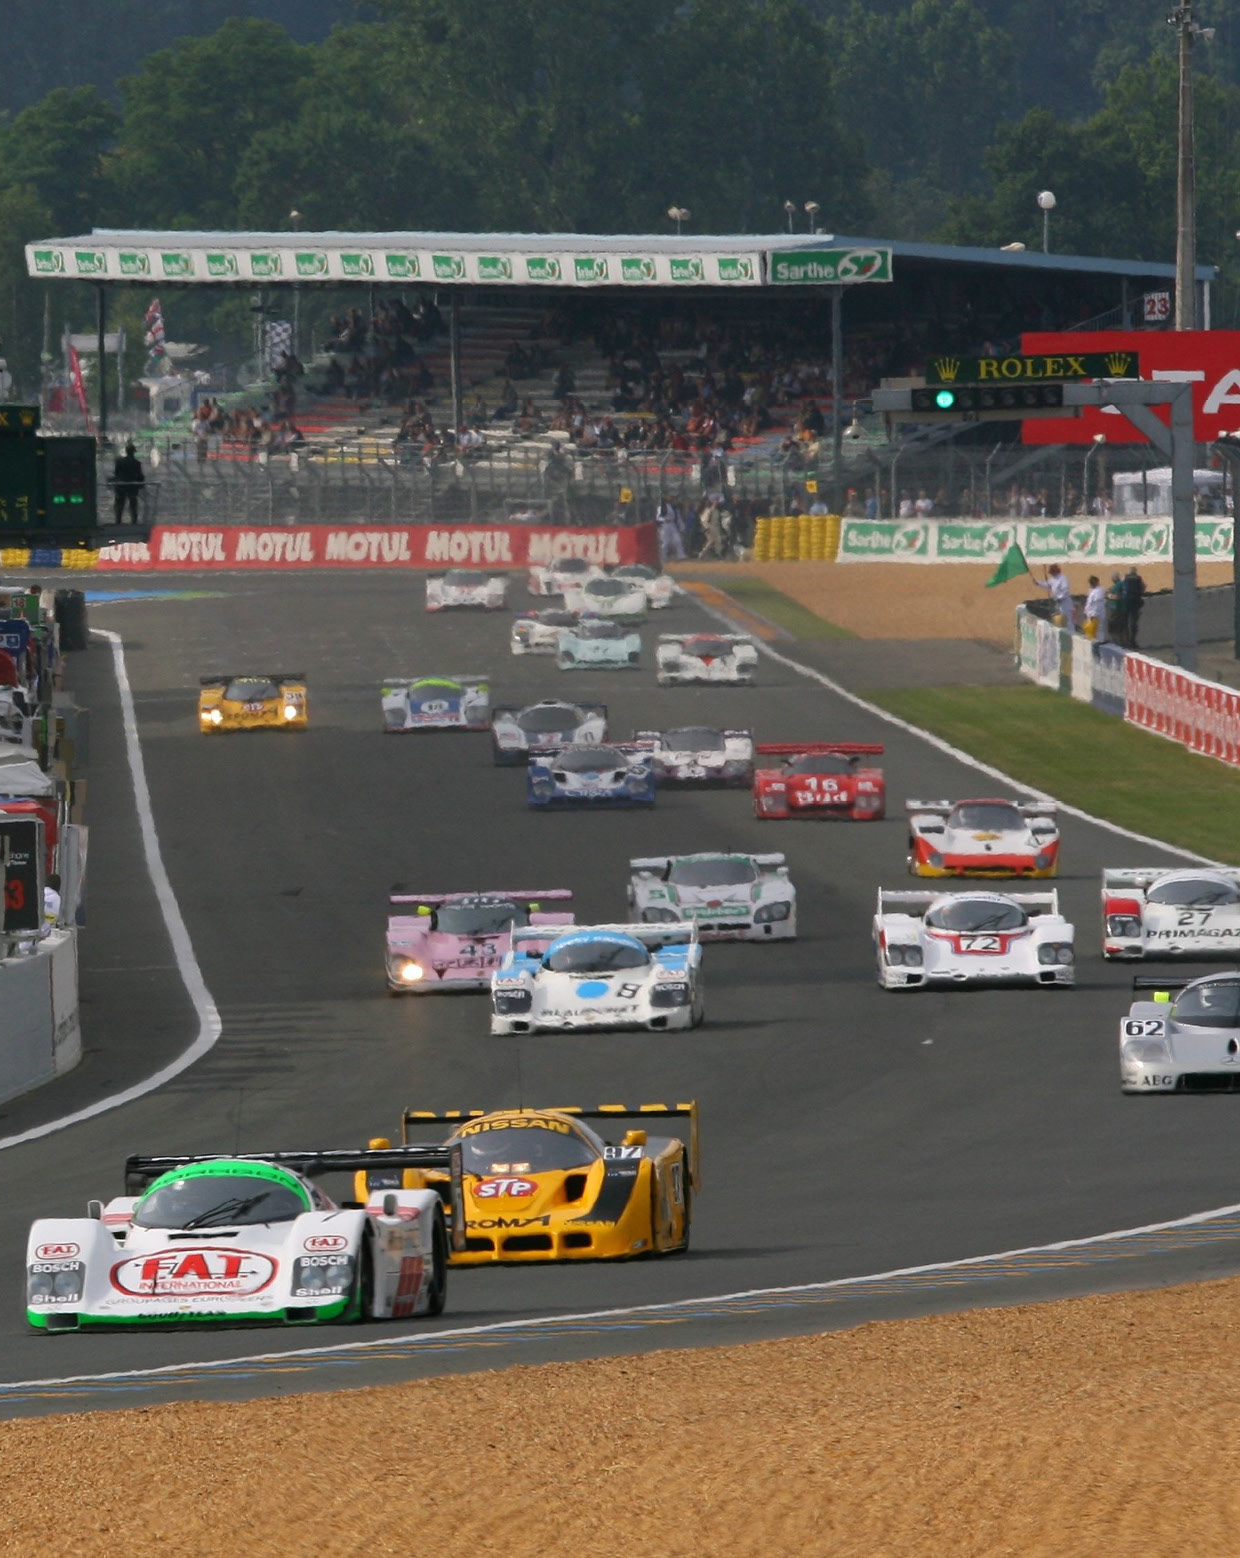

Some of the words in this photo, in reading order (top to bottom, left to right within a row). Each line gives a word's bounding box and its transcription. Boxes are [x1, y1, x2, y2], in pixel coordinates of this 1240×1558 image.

[776, 262, 834, 280] Sarthe
[1146, 298, 1170, 315] 23
[978, 356, 1088, 381] ROLEX
[160, 531, 226, 562] MOTUL
[235, 531, 314, 562] MOTUL
[325, 531, 411, 562] MOTUL
[425, 530, 513, 563] MOTUL
[846, 529, 891, 548] Sarthe
[1107, 531, 1142, 550] Sarthe
[527, 531, 620, 564] MOTUL
[1177, 911, 1213, 926] 27
[459, 942, 498, 957] 43
[961, 936, 1000, 951] 72
[615, 982, 642, 999] 8
[1125, 1021, 1165, 1036] 62
[1142, 1075, 1173, 1086] AEG
[461, 1118, 570, 1138] NISSAN
[478, 1178, 532, 1197] STP
[32, 1262, 80, 1273] BOSCH
[300, 1256, 349, 1267] BOSCH
[138, 1280, 243, 1290] INTERNATIONAL
[295, 1286, 343, 1296] Shell
[31, 1293, 79, 1304] Shell
